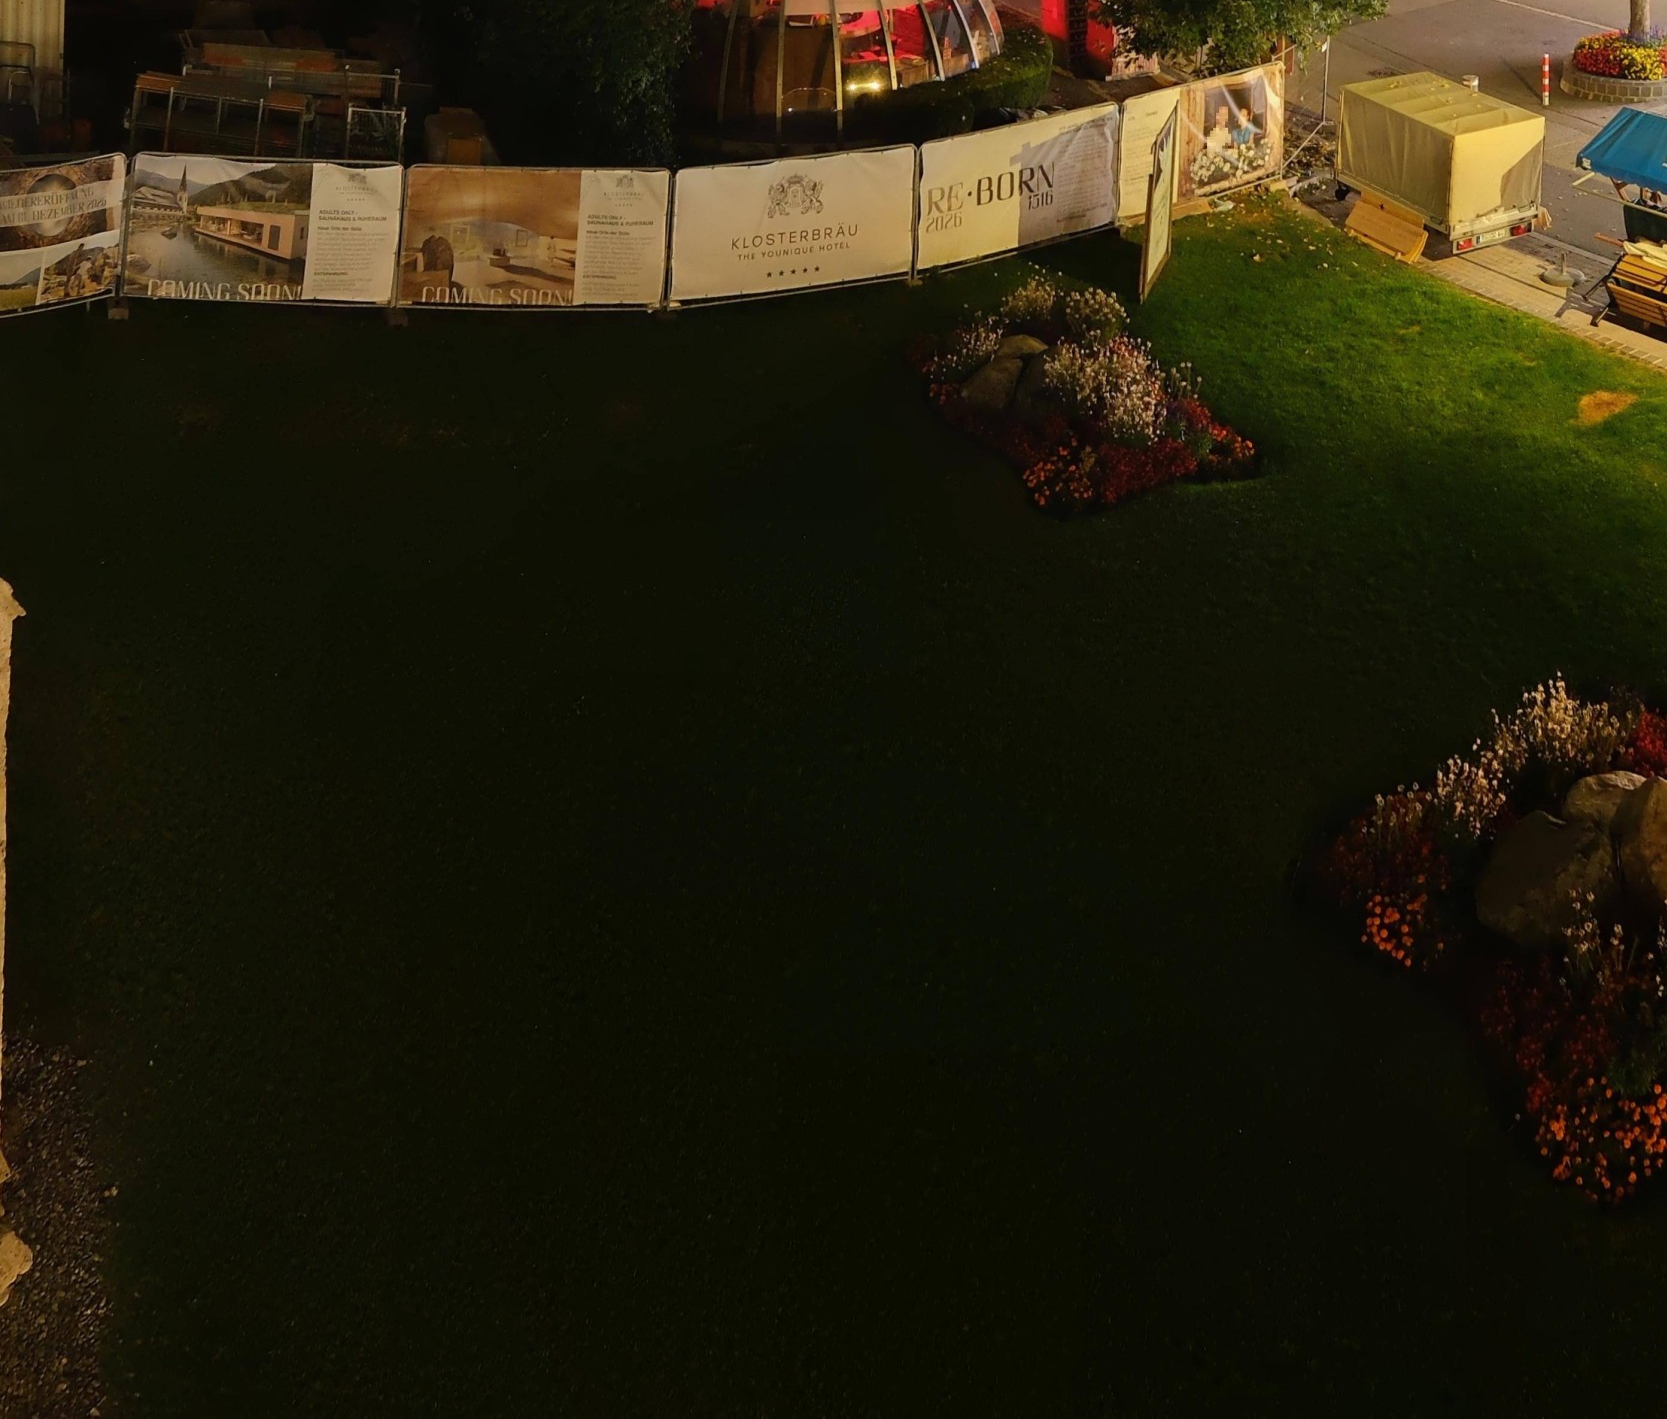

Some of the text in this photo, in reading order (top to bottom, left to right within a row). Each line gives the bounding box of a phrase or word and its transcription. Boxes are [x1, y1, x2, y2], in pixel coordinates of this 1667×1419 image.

[1028, 191, 1053, 211] 1516
[925, 213, 963, 234] 2026
[731, 222, 860, 251] KLOSTERBRÄU
[737, 242, 851, 262] THE YOUNIQUE HOTEL
